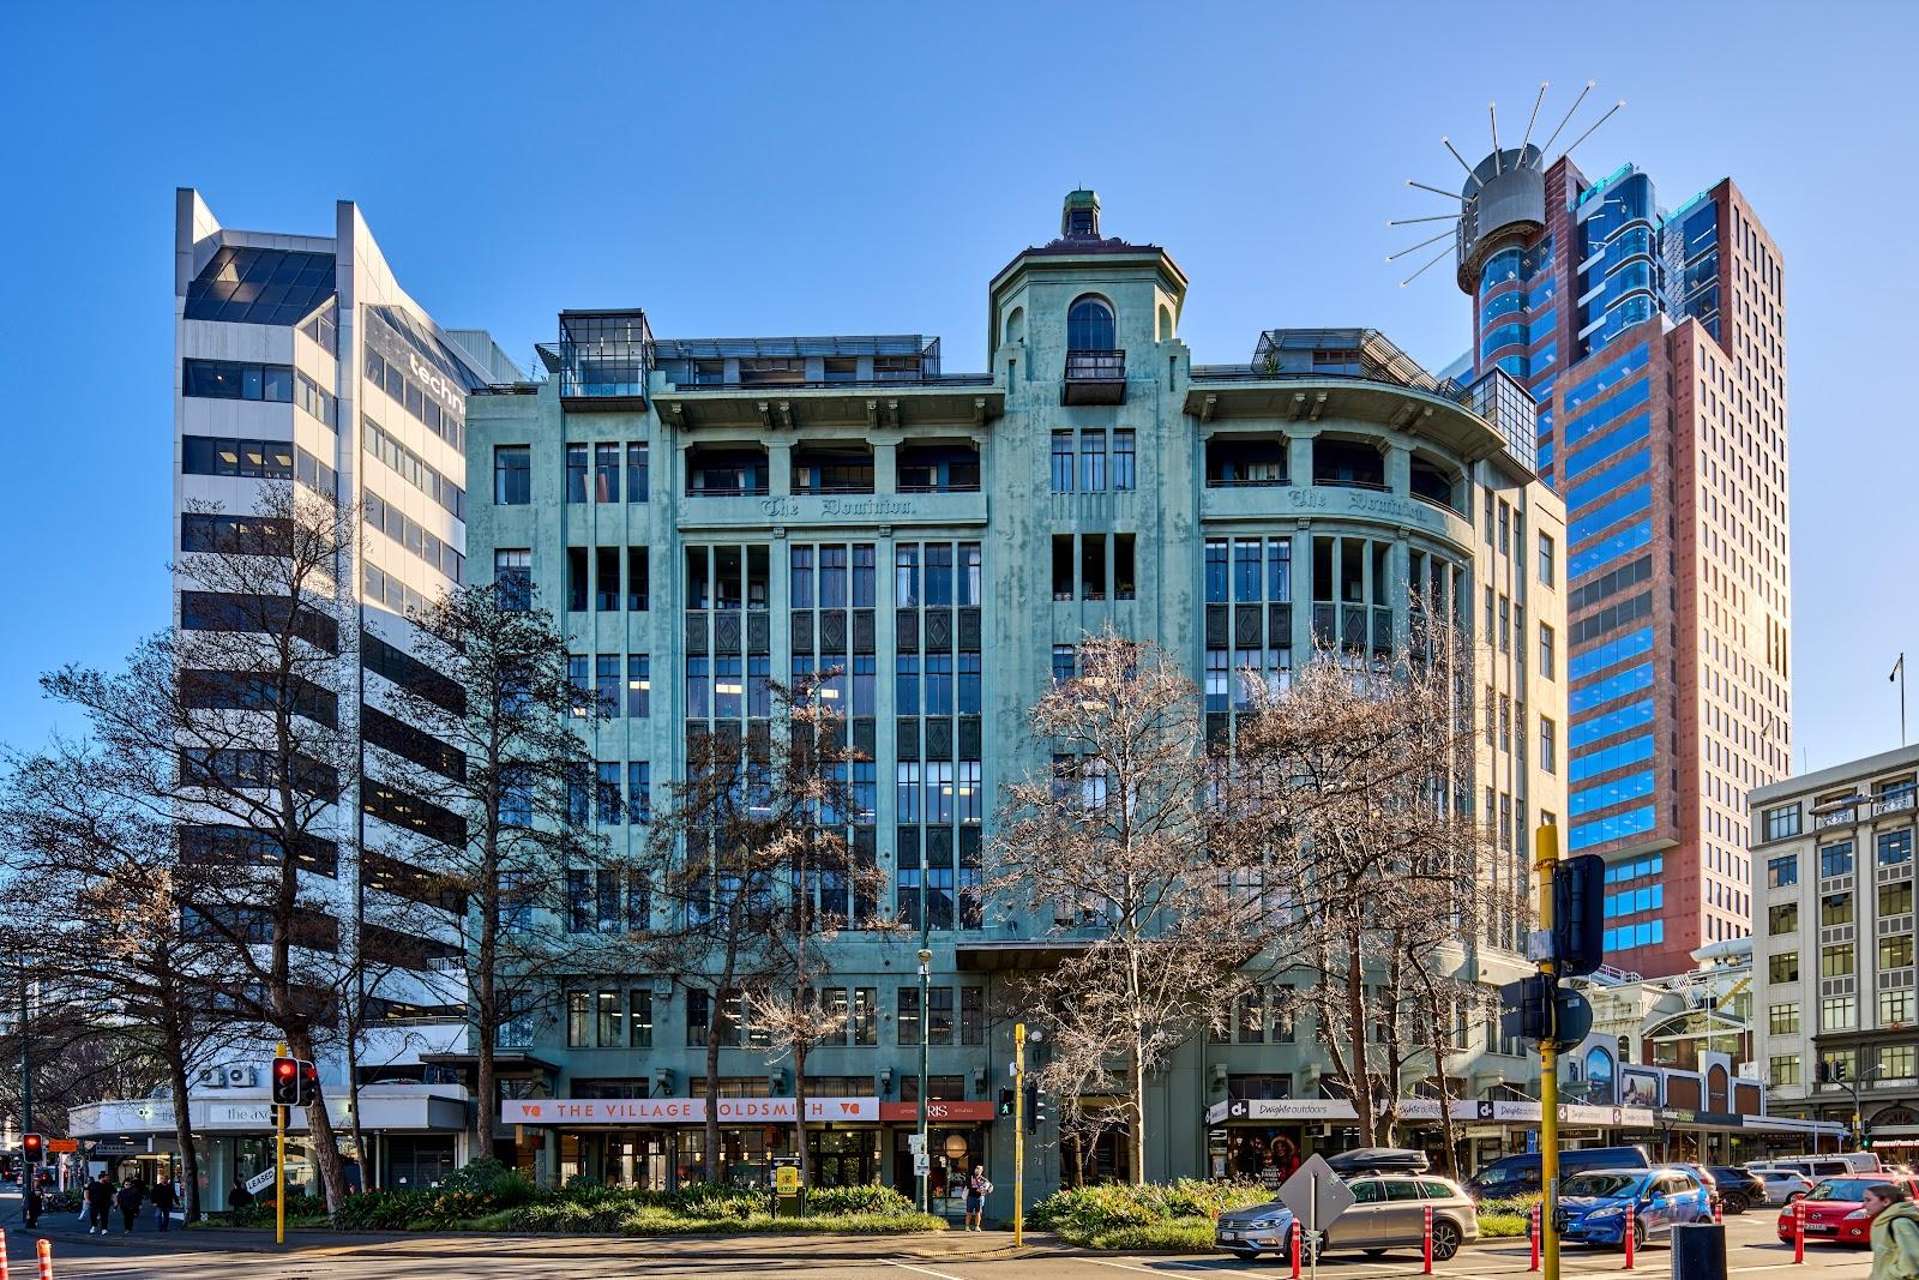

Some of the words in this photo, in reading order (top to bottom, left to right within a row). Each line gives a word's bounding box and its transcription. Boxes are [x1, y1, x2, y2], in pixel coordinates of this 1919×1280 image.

[760, 496, 800, 518] The
[227, 1108, 248, 1120] the
[557, 1104, 594, 1117] THE
[606, 1103, 692, 1117] VILLAGE
[703, 1102, 824, 1117] OLDSMIH
